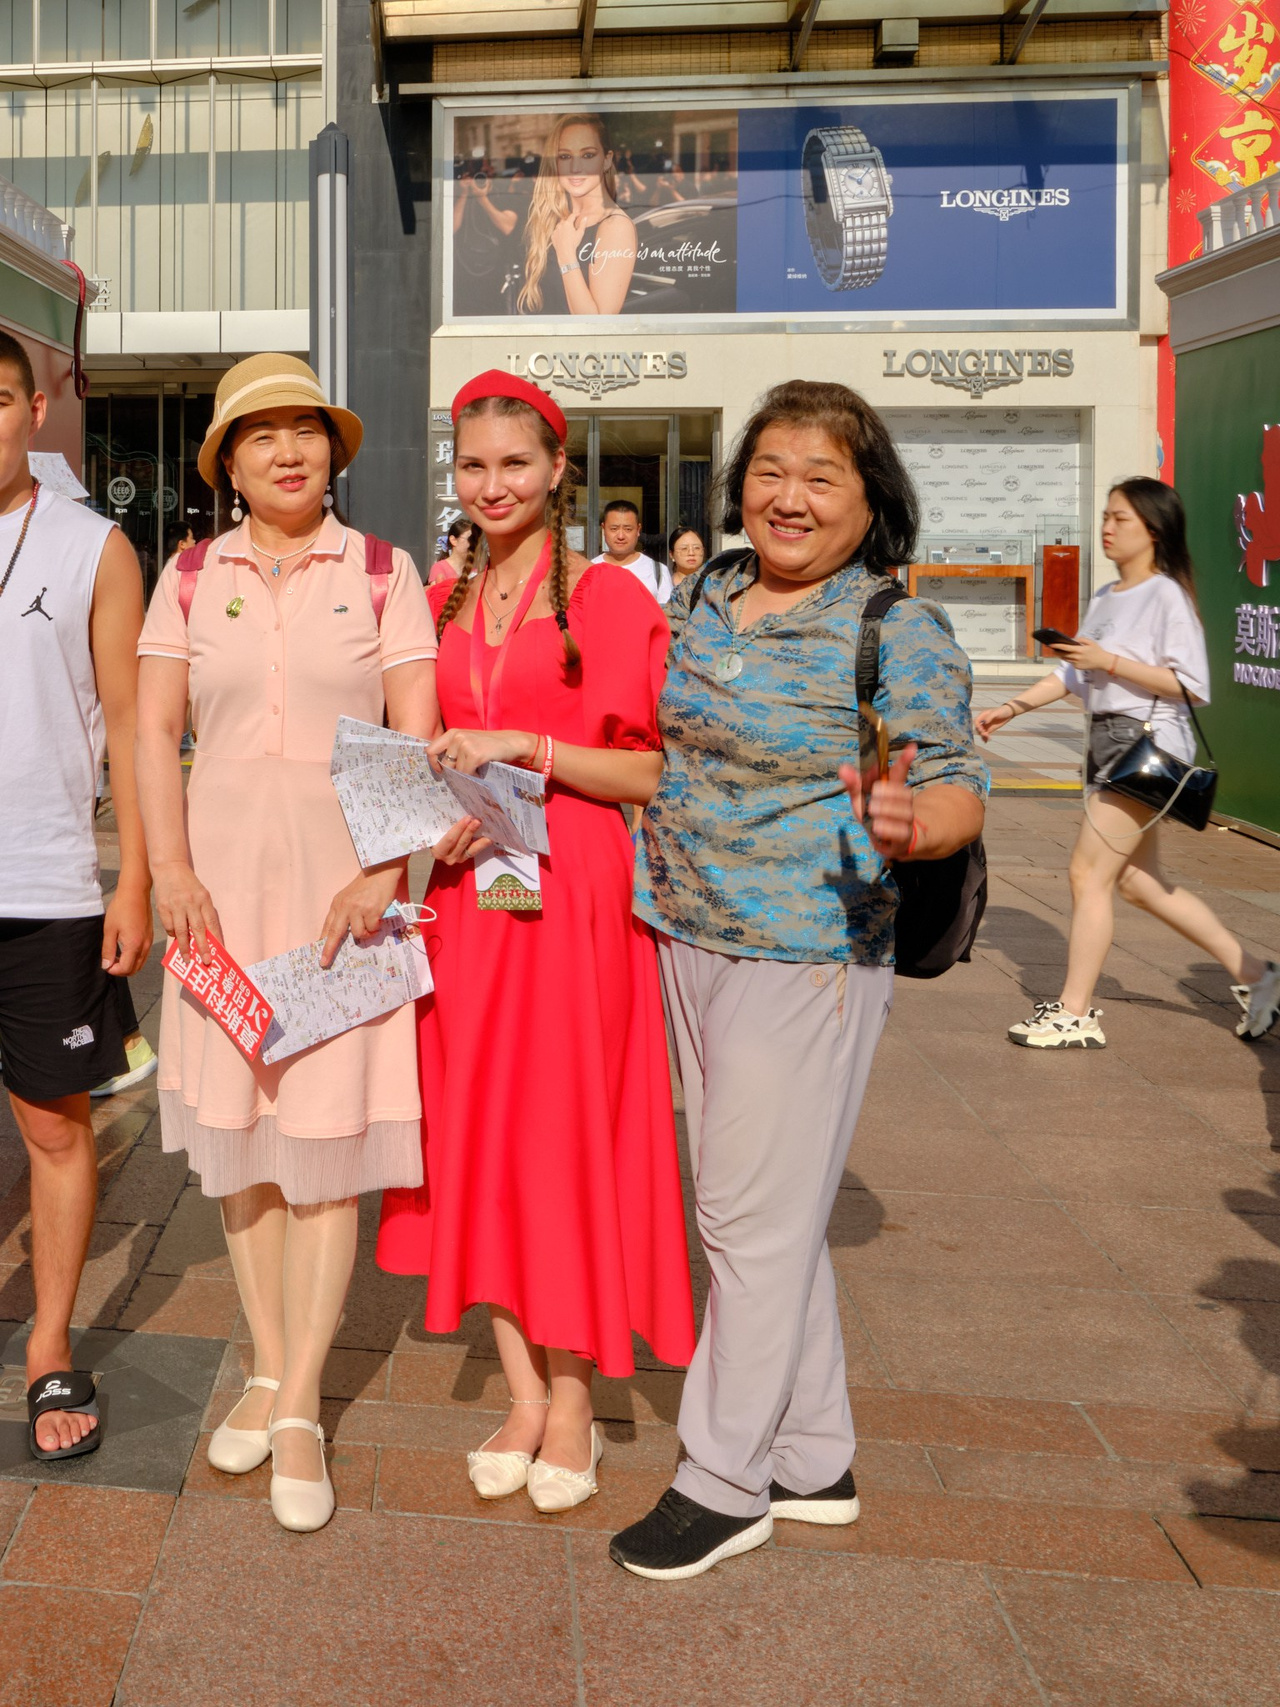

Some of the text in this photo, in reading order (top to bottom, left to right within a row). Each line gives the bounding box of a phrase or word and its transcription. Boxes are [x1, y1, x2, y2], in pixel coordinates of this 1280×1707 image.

[940, 188, 1070, 208] LONGINES
[578, 238, 727, 276] Elegance is an attitude
[507, 351, 688, 379] LONGINES
[883, 349, 1075, 377] LONGINES
[1234, 603, 1280, 658] 莫斯
[35, 1387, 72, 1403] JOSS
